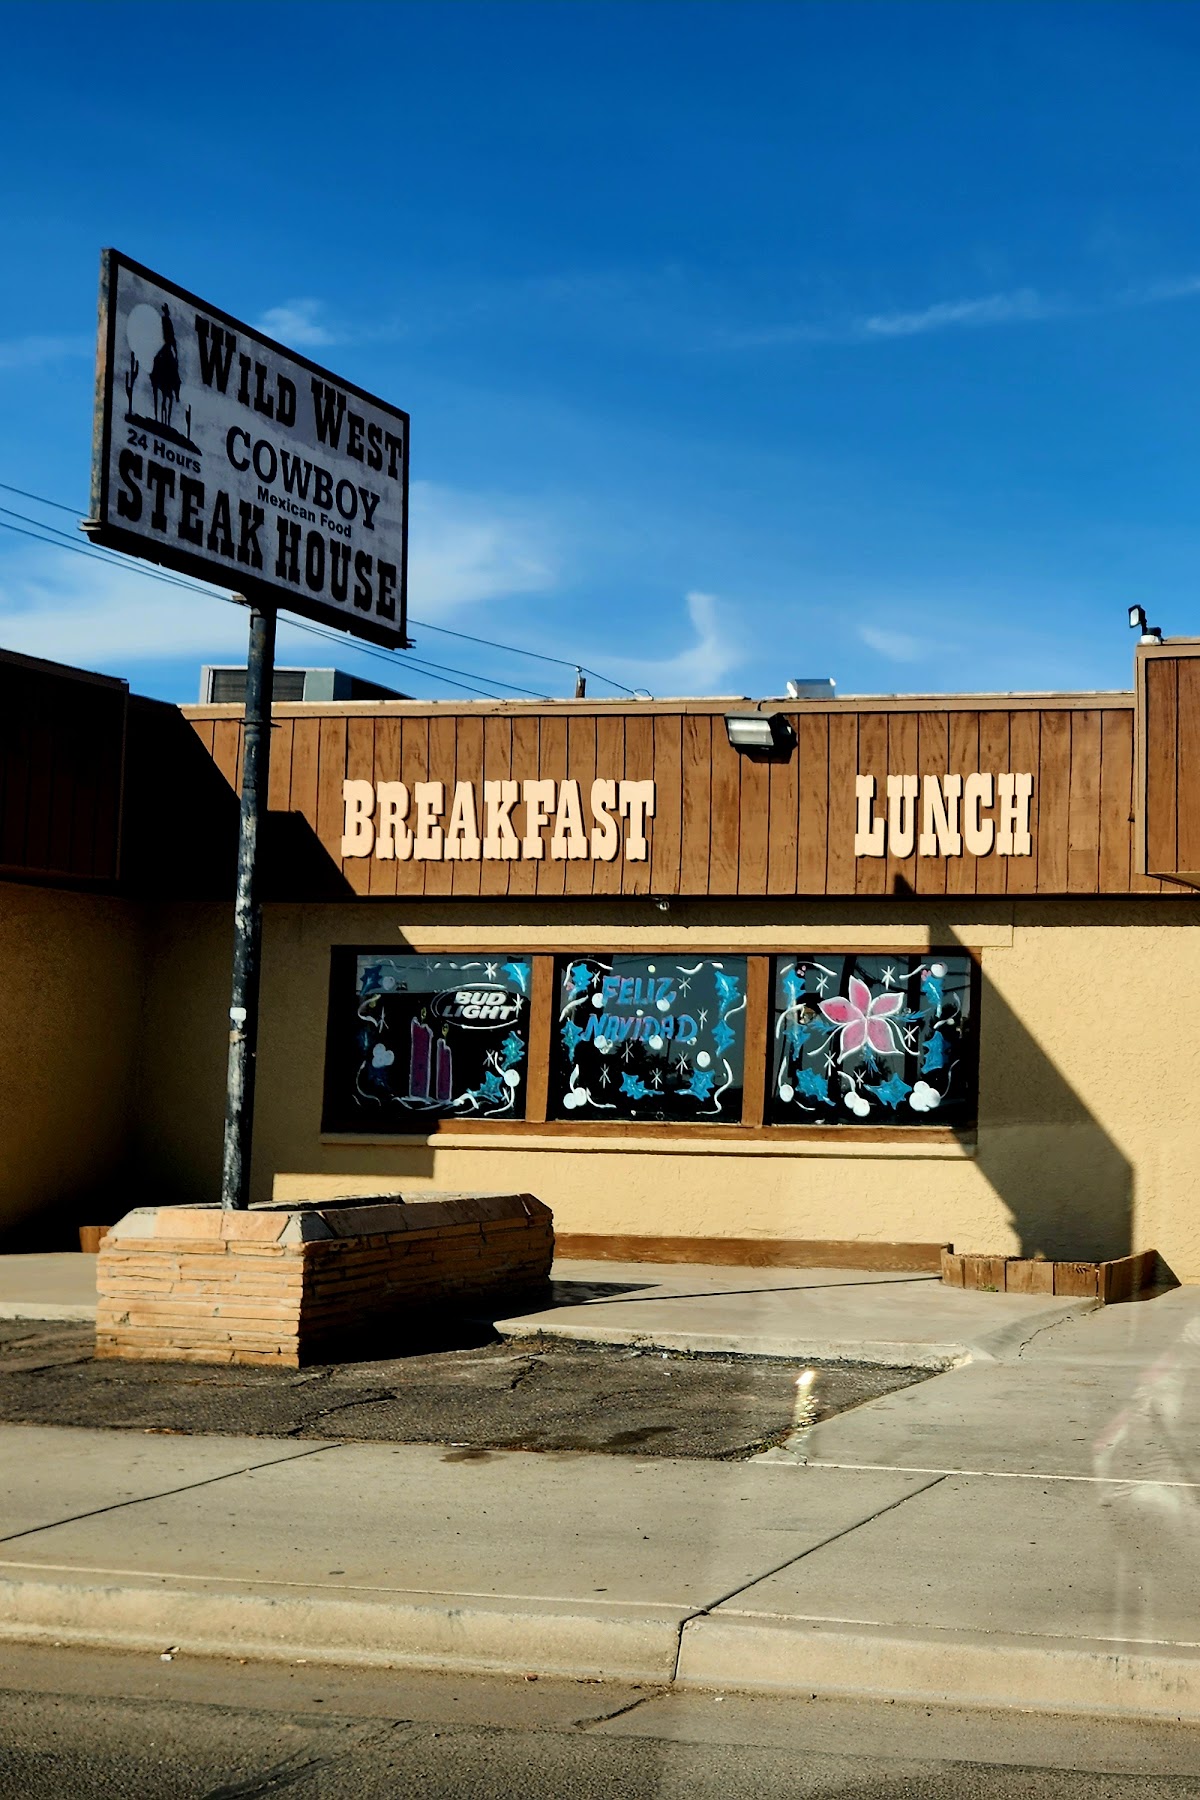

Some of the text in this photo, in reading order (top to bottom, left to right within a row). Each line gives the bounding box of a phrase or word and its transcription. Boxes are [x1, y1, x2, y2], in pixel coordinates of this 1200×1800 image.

[195, 313, 402, 480] WILD WEST
[127, 428, 201, 474] 24 Hours
[226, 426, 380, 531] COWBOY
[117, 448, 397, 622] STEAK HOUSE
[257, 485, 352, 539] Mexican Food
[341, 778, 655, 862] BREAKFAST
[854, 771, 1033, 858] LUNCH
[442, 1004, 516, 1021] LIGHT
[454, 991, 507, 1006] BUD
[602, 974, 677, 1008] FELIZ
[584, 1013, 698, 1043] NAVIDAD
